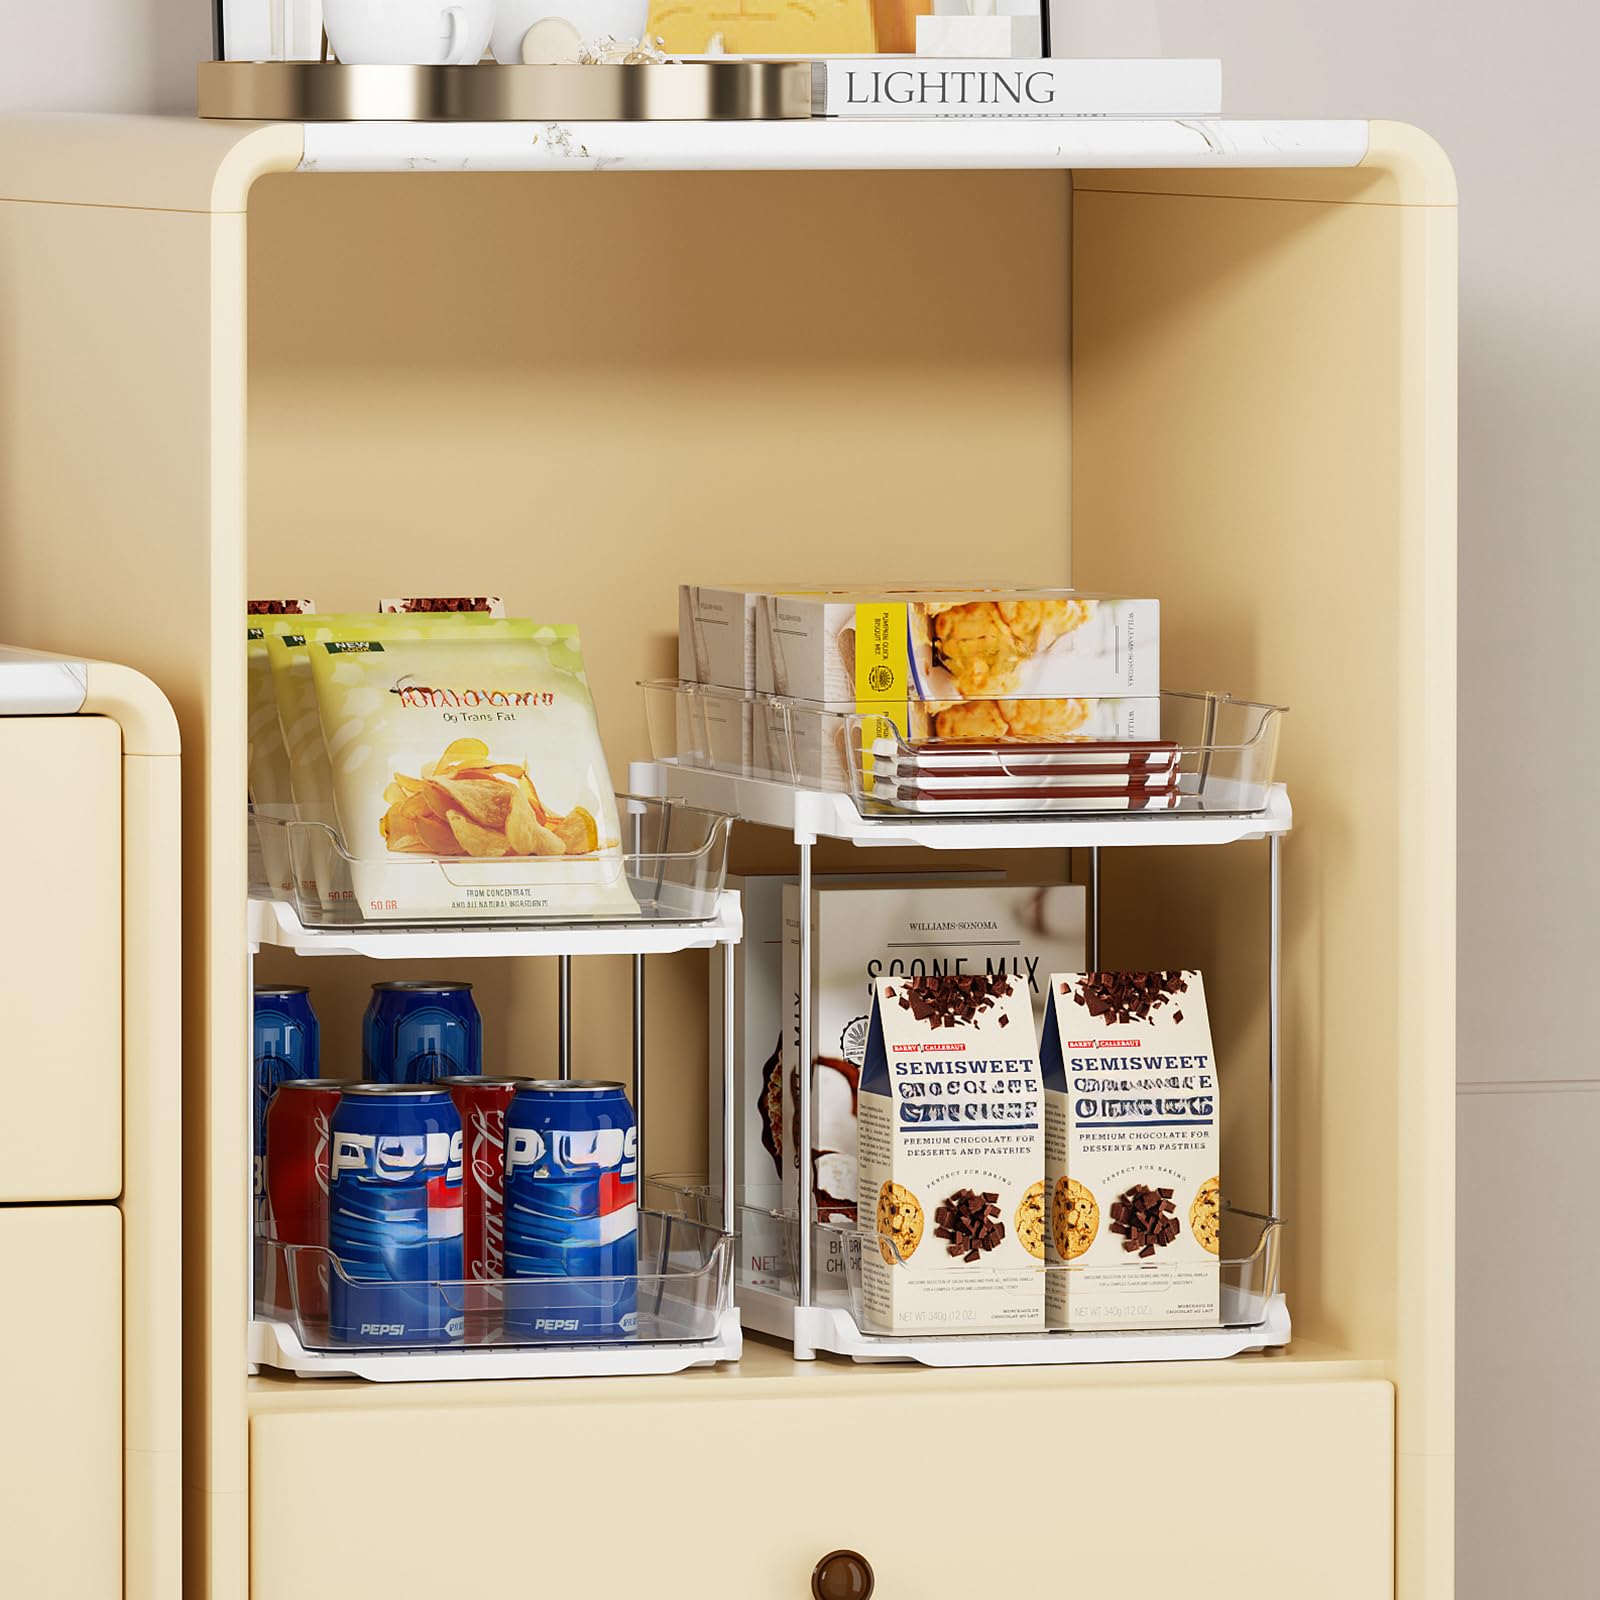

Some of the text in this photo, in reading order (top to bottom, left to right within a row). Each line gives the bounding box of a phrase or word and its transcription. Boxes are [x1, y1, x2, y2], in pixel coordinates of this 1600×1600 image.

[845, 71, 1056, 105] LIGHTING
[335, 641, 370, 649] NEW
[460, 712, 493, 722] Trans
[496, 712, 517, 722] Fat
[328, 892, 341, 901] 50
[466, 888, 532, 897] FROM CONCENTRATE
[370, 900, 398, 910] 50 GR
[895, 1059, 1034, 1076] SEMISWEET
[1071, 1055, 1208, 1072] SEMISWEET
[903, 1137, 951, 1145] PREMIUM
[953, 1135, 1013, 1144] CHOCOLATE
[1079, 1133, 1126, 1141] PREMIUM
[1128, 1131, 1188, 1140] CHOCOLATE
[907, 1146, 1032, 1157] DESSERTS AND PASTRIES
[1082, 1142, 1206, 1153] DESSERTS AND PASTRIES
[899, 1311, 914, 1322] NET
[915, 1311, 927, 1321] WT
[928, 1311, 947, 1322] 340g
[948, 1310, 961, 1321] (12
[360, 1323, 405, 1336] PEPSI
[535, 1318, 580, 1331] PEPSI
